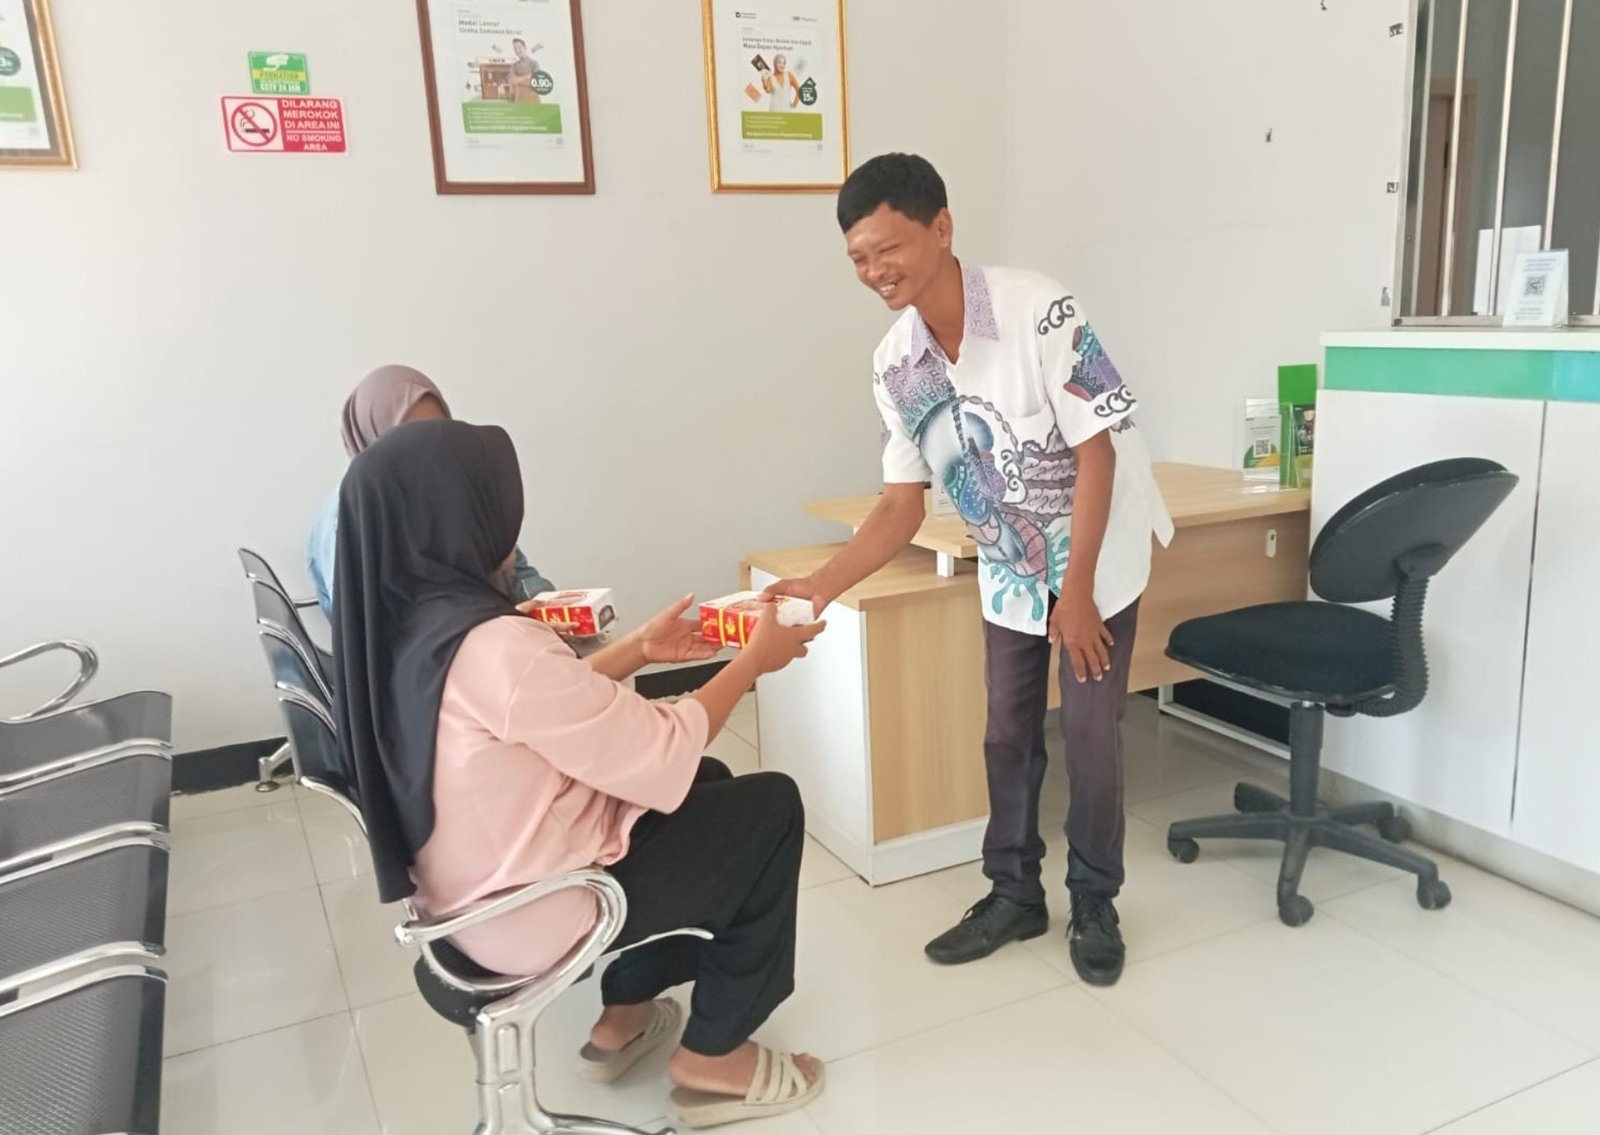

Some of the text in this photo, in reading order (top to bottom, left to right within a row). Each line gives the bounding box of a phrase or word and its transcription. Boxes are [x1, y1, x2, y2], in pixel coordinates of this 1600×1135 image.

[281, 99, 338, 109] DILARANG
[283, 110, 339, 119] MEROKOK
[284, 120, 340, 129] DI AREA INI
[286, 134, 342, 143] NO SMOKING
[303, 143, 328, 151] AREA
